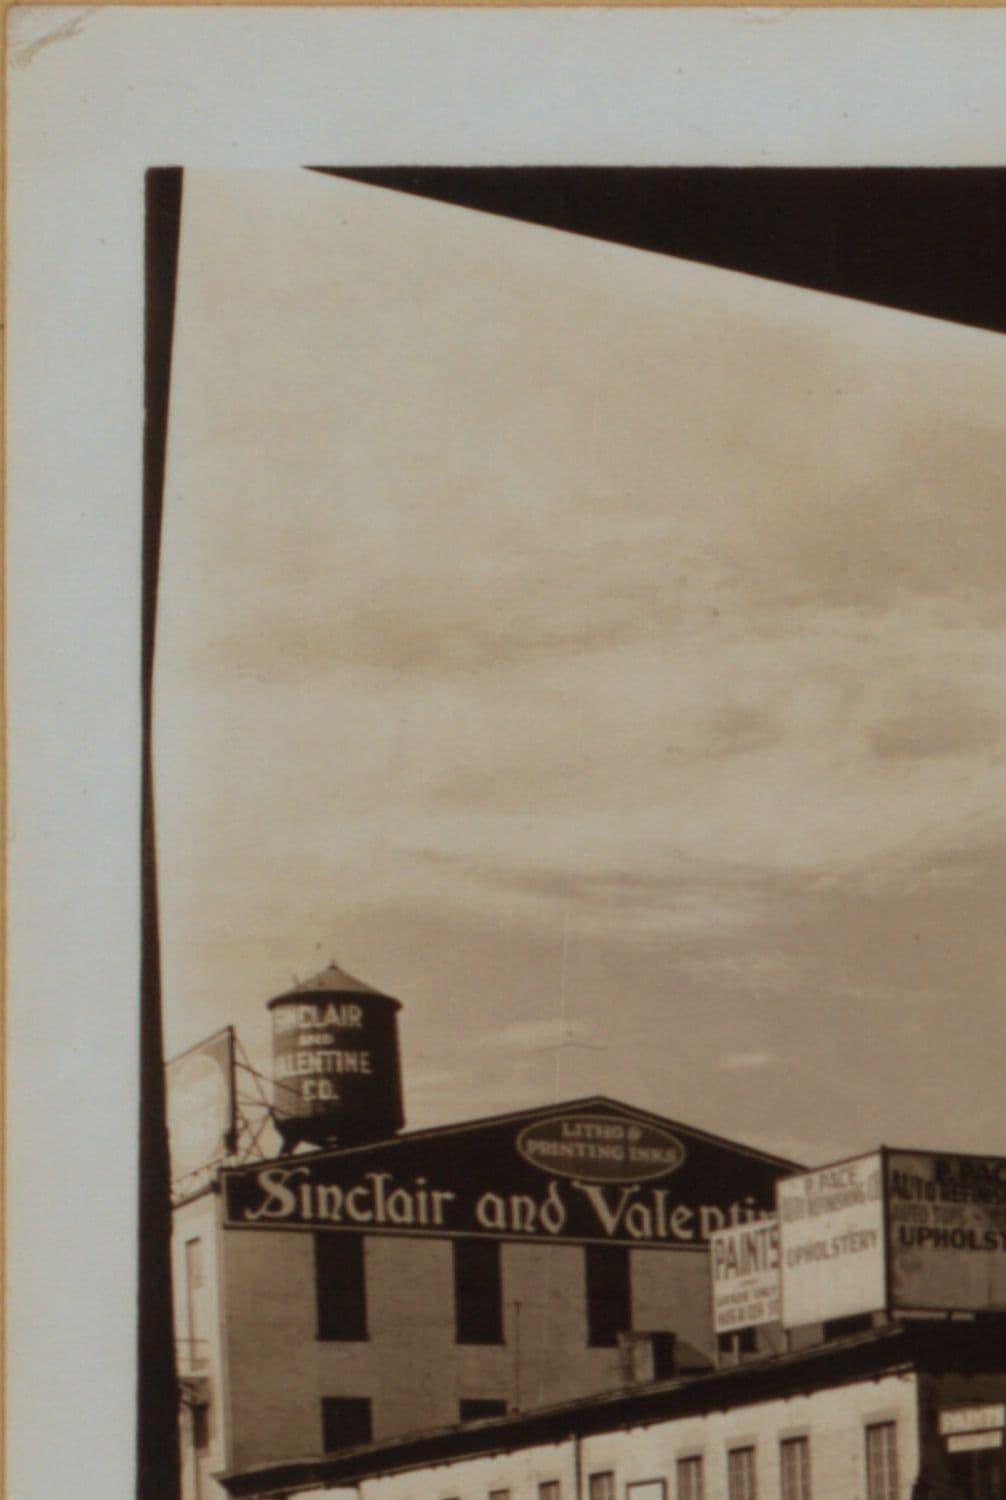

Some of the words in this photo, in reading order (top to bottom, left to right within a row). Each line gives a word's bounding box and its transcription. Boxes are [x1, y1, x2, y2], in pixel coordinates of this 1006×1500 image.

[526, 1138, 623, 1161] PRINTING
[629, 1147, 677, 1163] INKS
[244, 1167, 455, 1225] Sinclair
[475, 1185, 567, 1236] and
[786, 1228, 878, 1268] UPHOLSTERY
